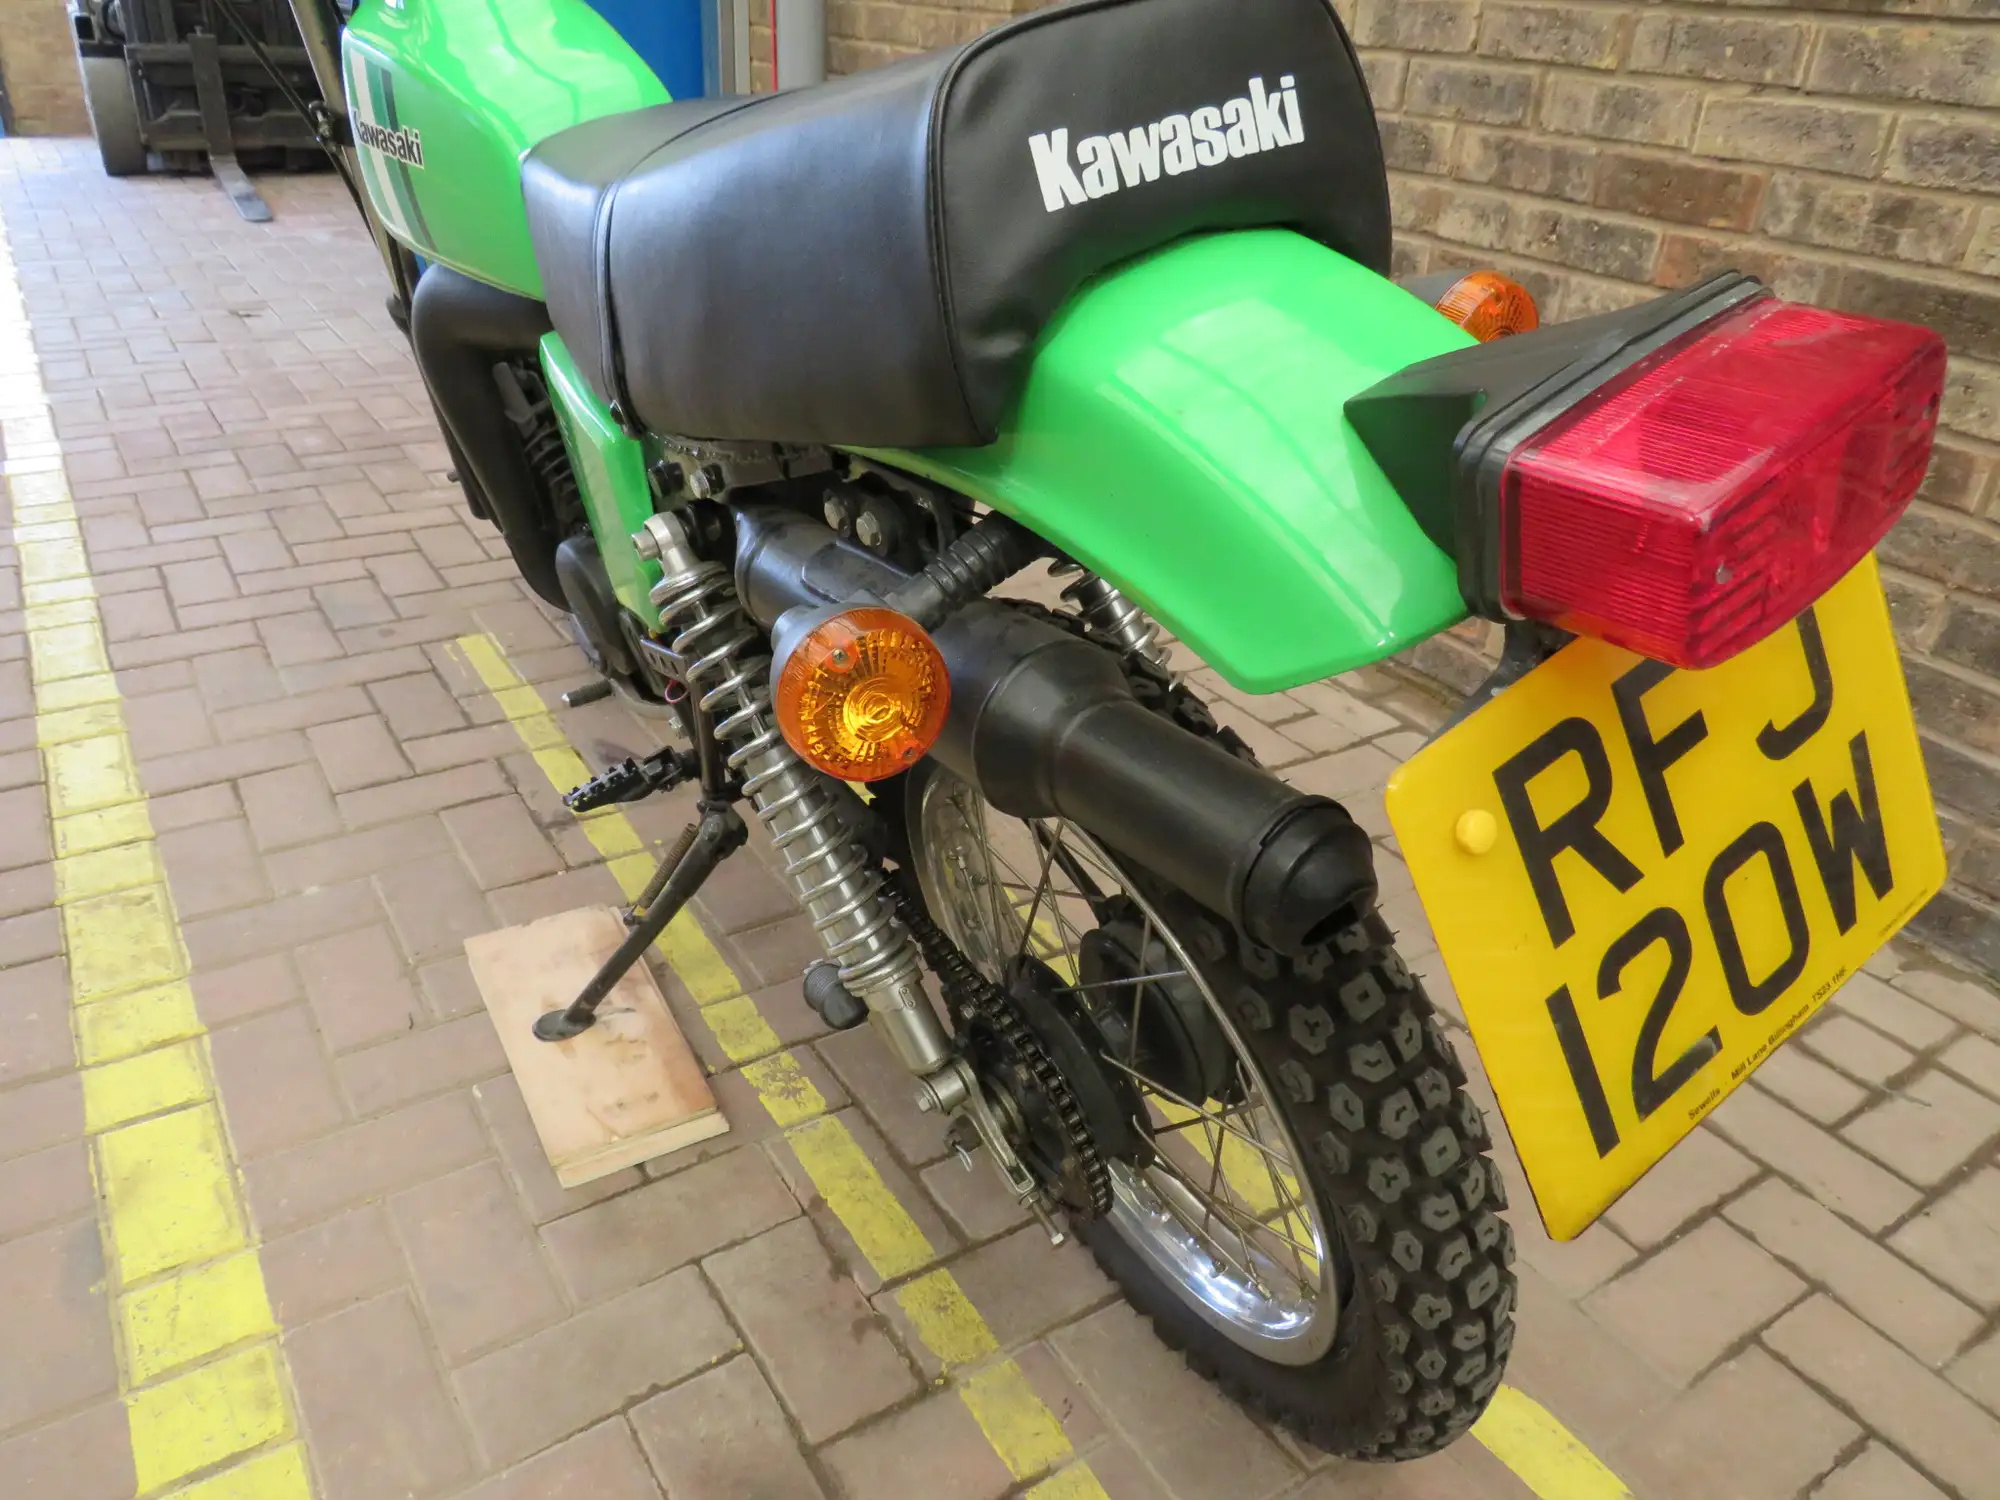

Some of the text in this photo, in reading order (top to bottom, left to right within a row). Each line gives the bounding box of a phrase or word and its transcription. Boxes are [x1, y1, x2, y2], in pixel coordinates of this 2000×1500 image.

[1028, 75, 1304, 212] Kawasaki
[1492, 606, 1834, 950] RFJ
[1545, 730, 1894, 1160] 120W
[1730, 1061, 1746, 1080] Mill
[1746, 1043, 1768, 1066] Lane
